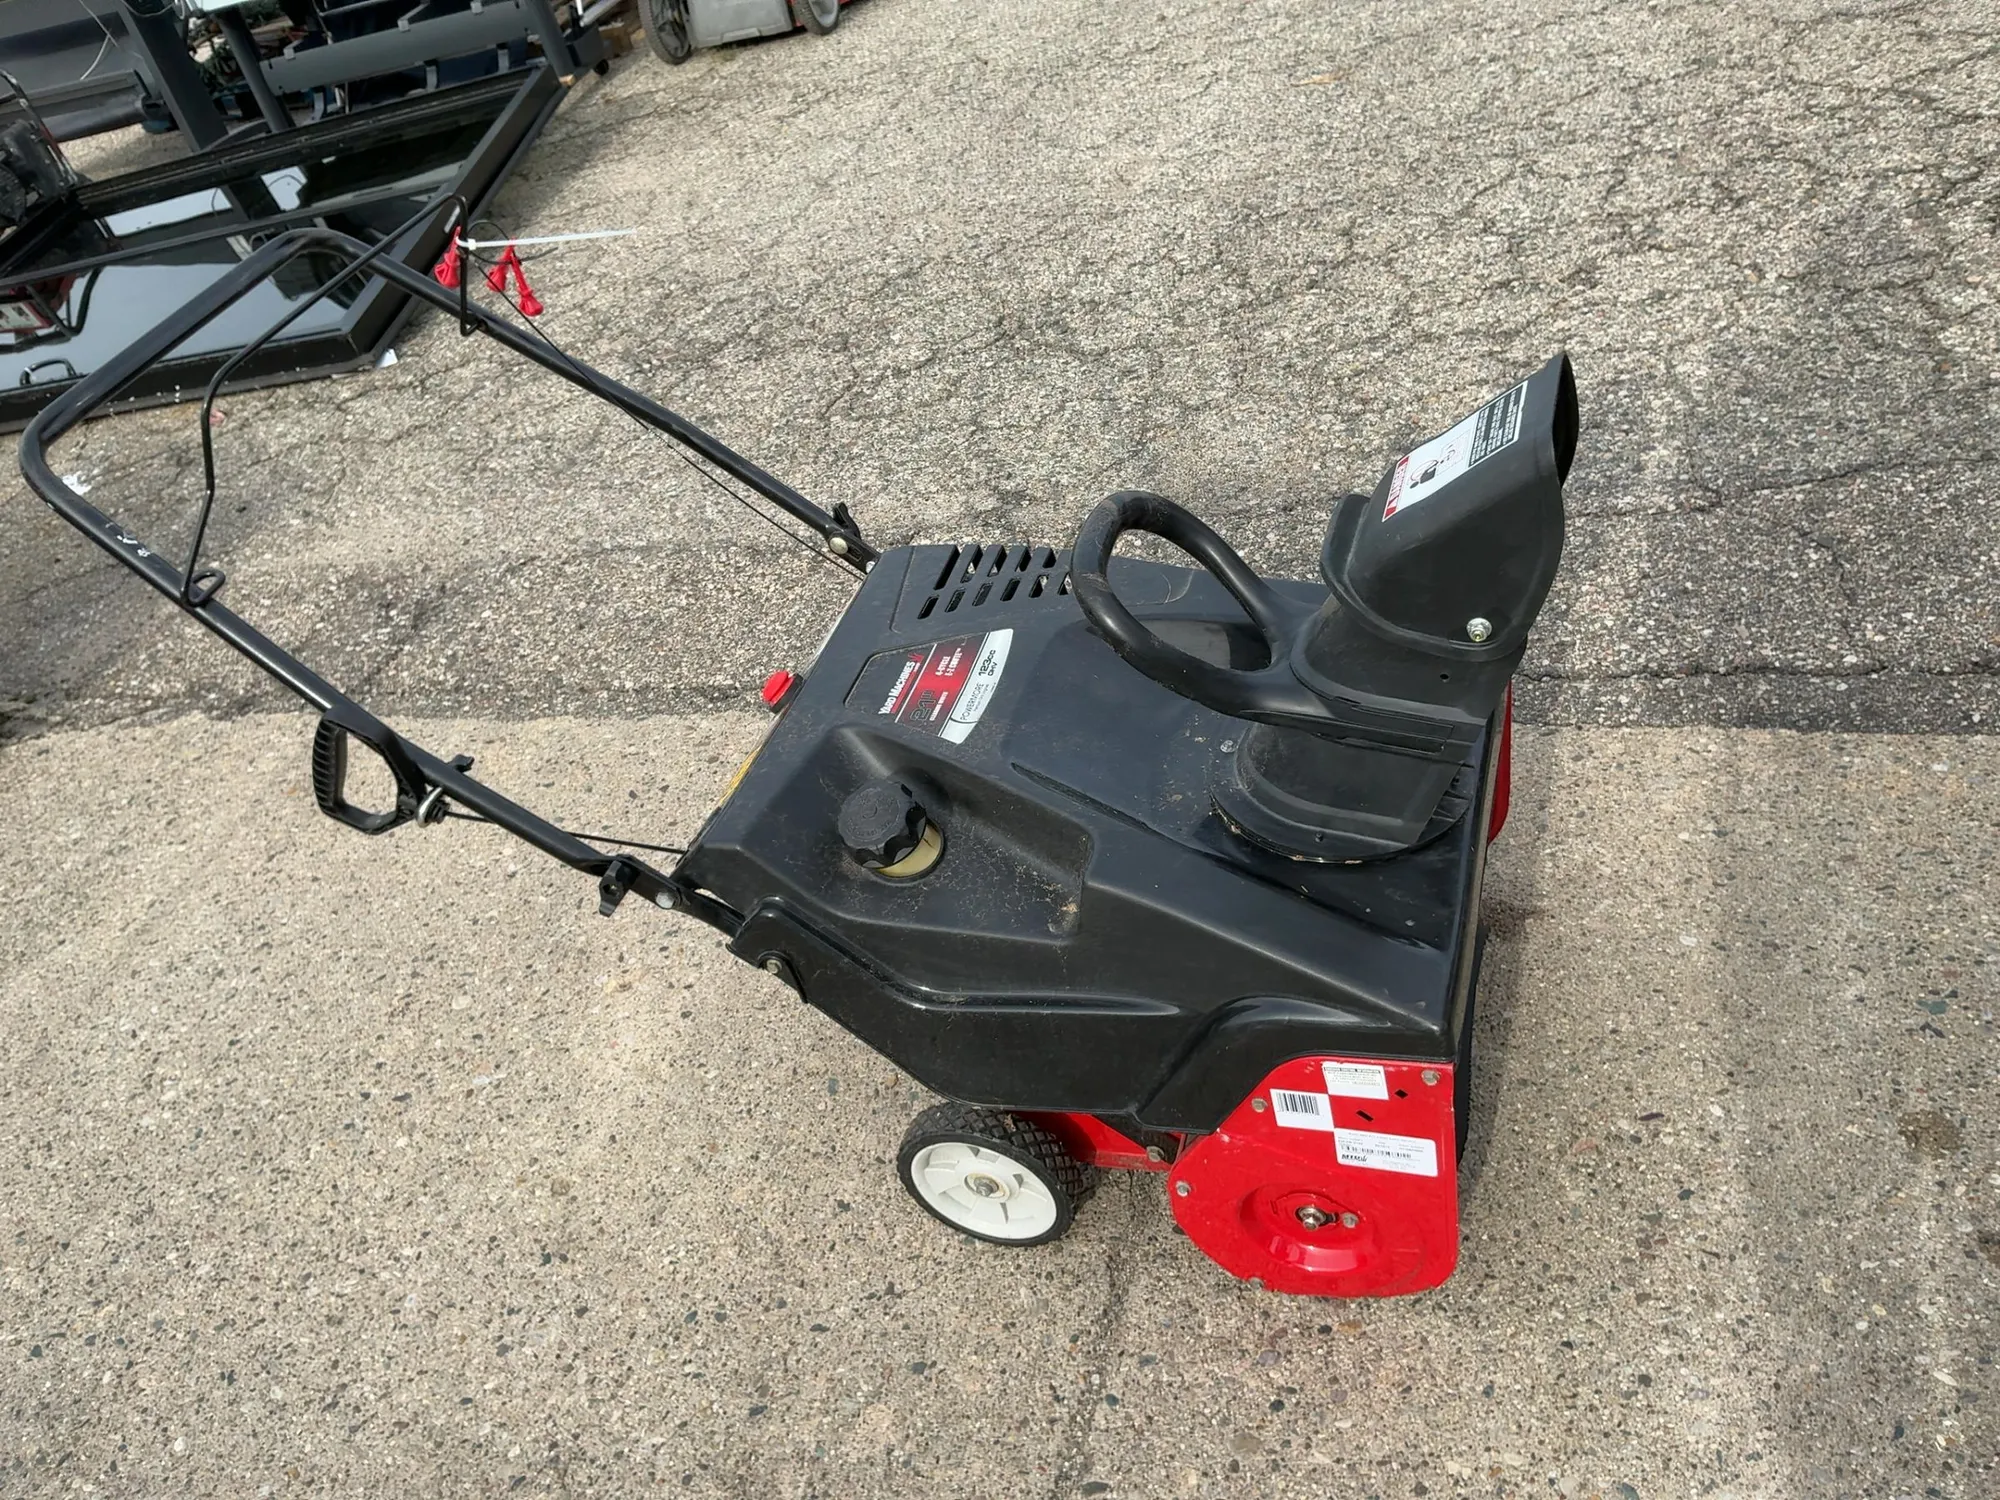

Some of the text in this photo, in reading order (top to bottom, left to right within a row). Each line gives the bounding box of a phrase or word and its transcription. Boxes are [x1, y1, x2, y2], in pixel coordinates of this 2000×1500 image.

[978, 649, 996, 676] 123cc
[987, 661, 998, 676] OHV
[878, 661, 915, 714] YARD MACHINES
[960, 682, 984, 720] POWERMORE
